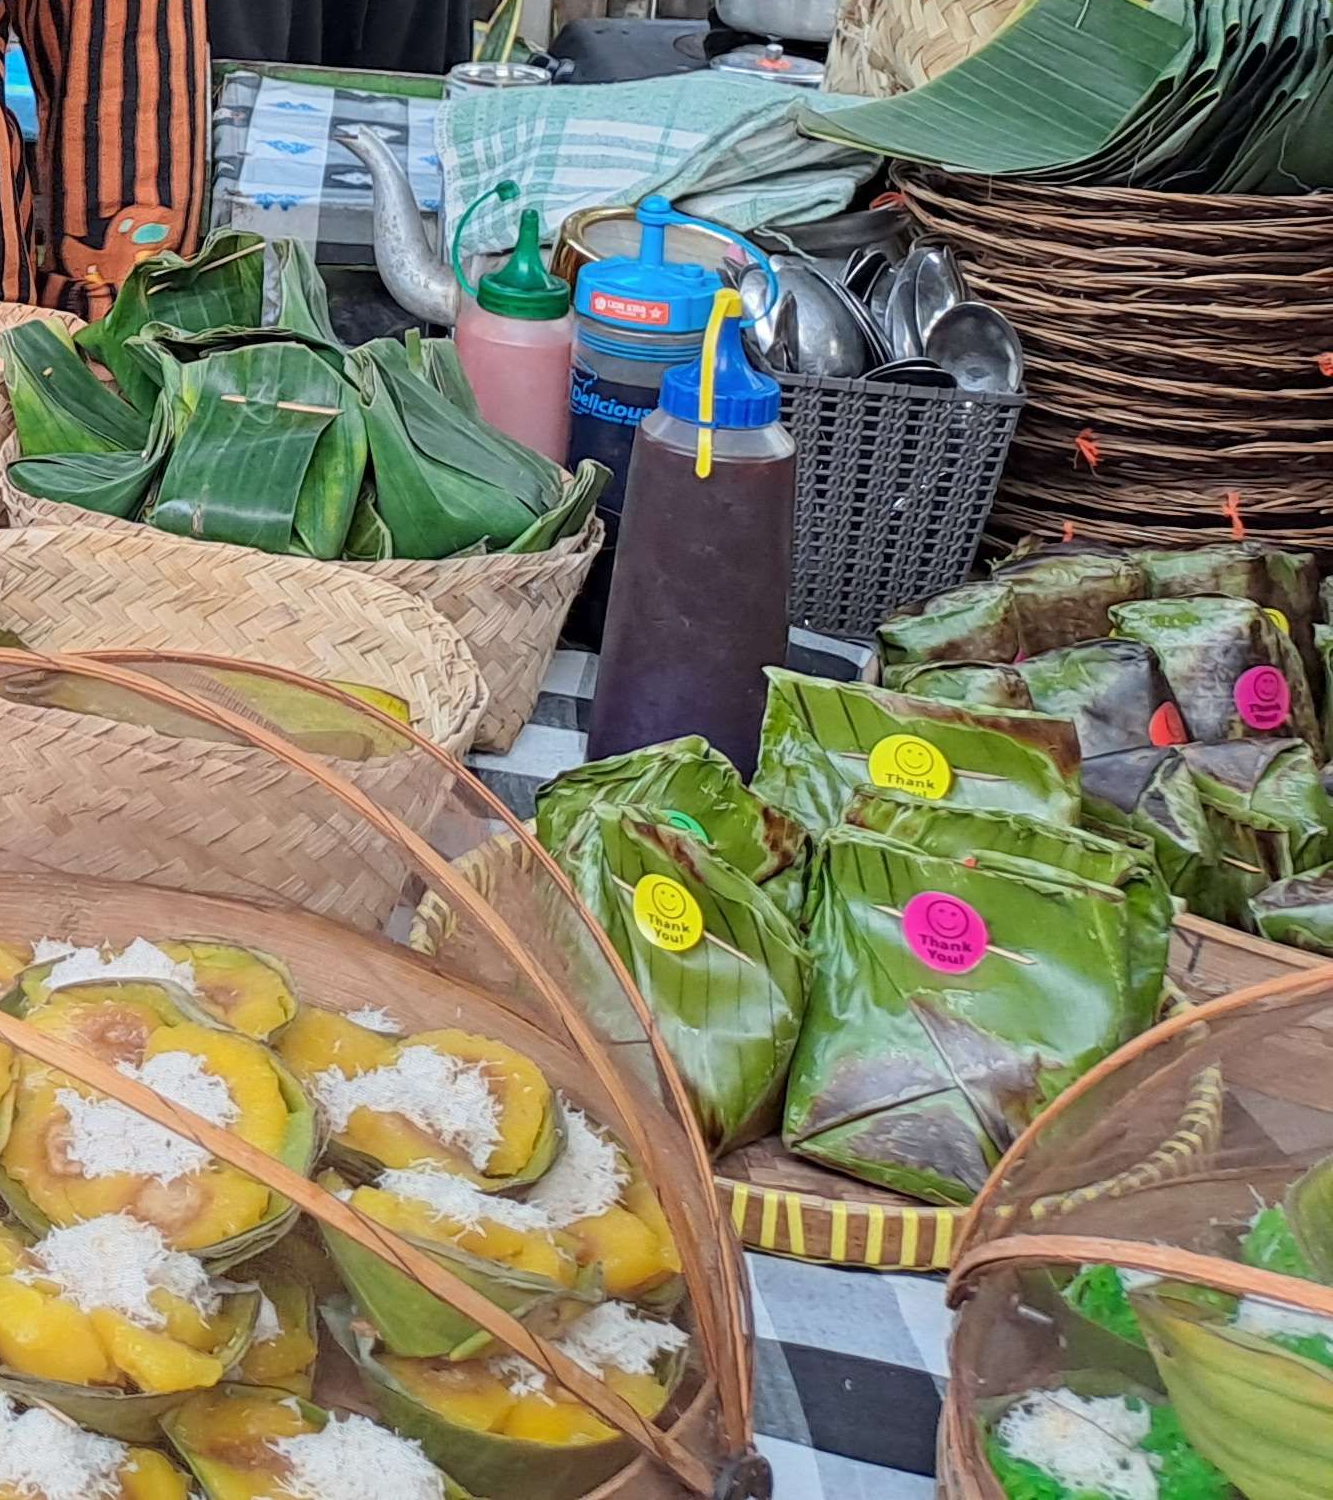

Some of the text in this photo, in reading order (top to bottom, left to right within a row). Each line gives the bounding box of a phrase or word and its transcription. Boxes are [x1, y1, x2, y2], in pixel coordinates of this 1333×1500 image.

[571, 384, 653, 419] Delicious
[885, 772, 935, 789] Thank
[647, 912, 691, 933] Thank
[917, 933, 973, 953] Thank
